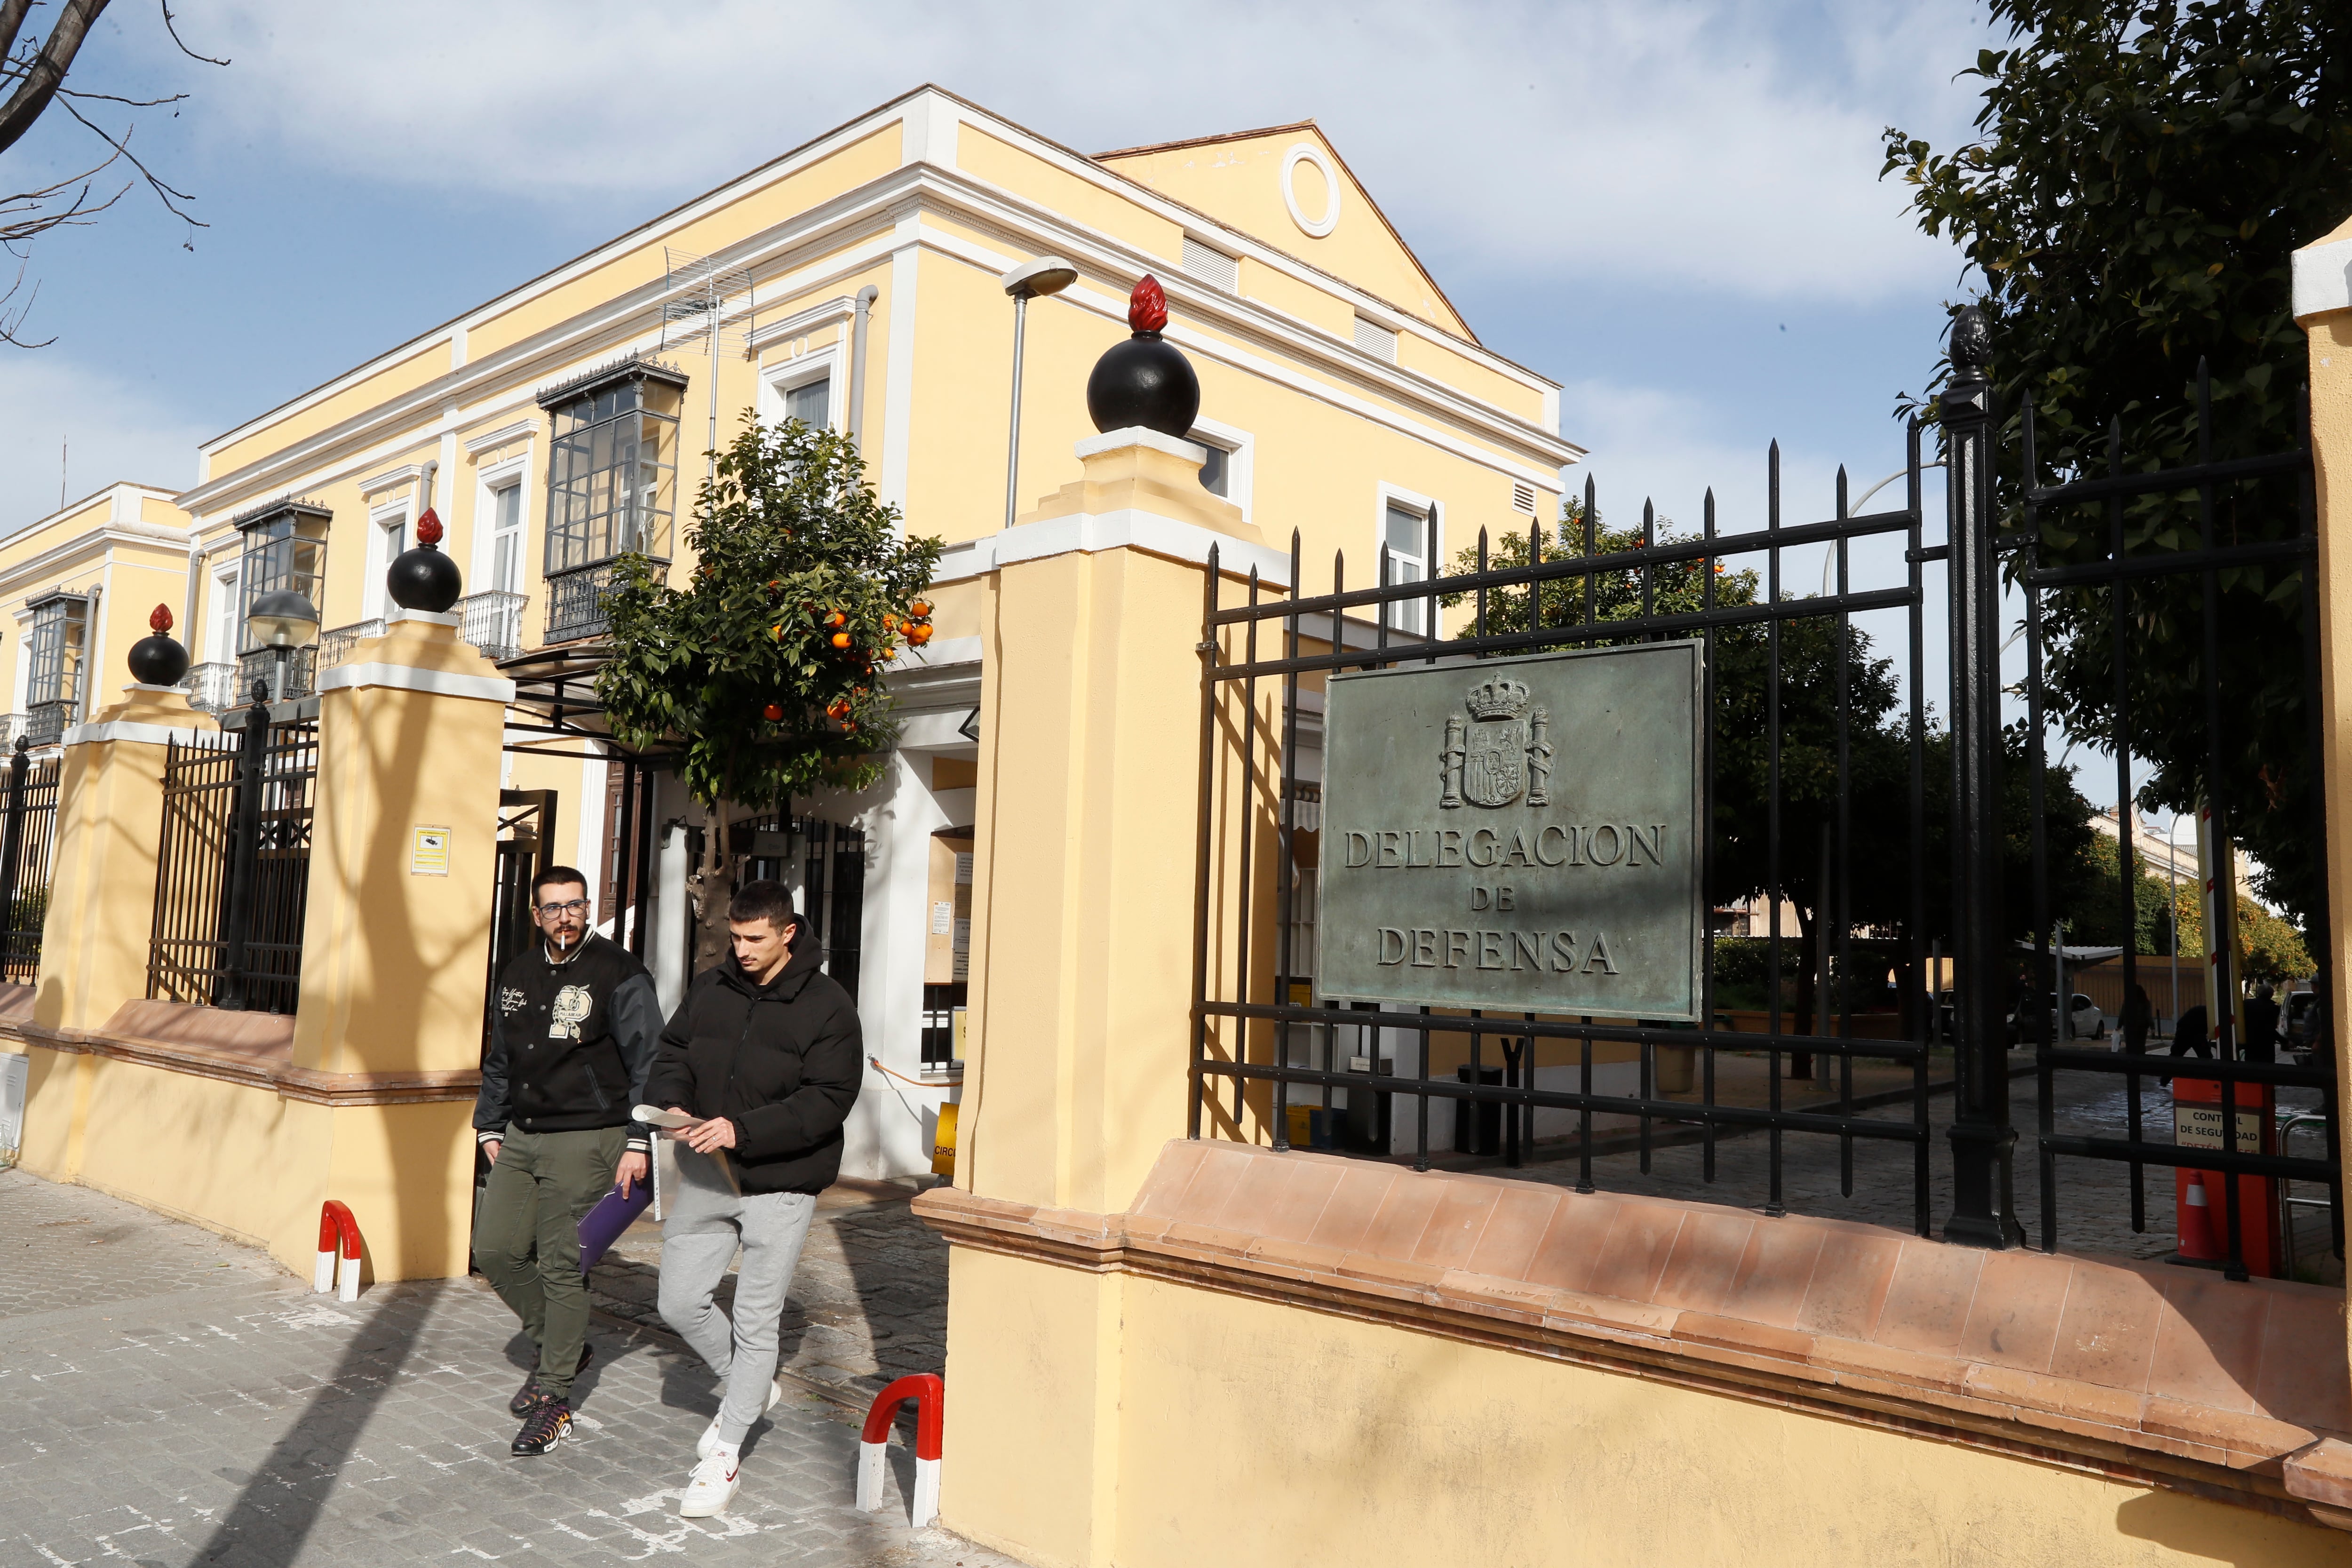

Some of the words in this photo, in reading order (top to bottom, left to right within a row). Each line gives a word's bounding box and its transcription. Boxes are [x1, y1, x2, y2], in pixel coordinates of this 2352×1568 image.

[1345, 824, 1666, 868] DELEGACION
[1471, 886, 1515, 910] DE
[1377, 928, 1621, 975] DEFENSA
[2193, 1112, 2243, 1125] CONTL
[2180, 1125, 2193, 1134] DE
[2195, 1127, 2257, 1141] SEGUDAD
